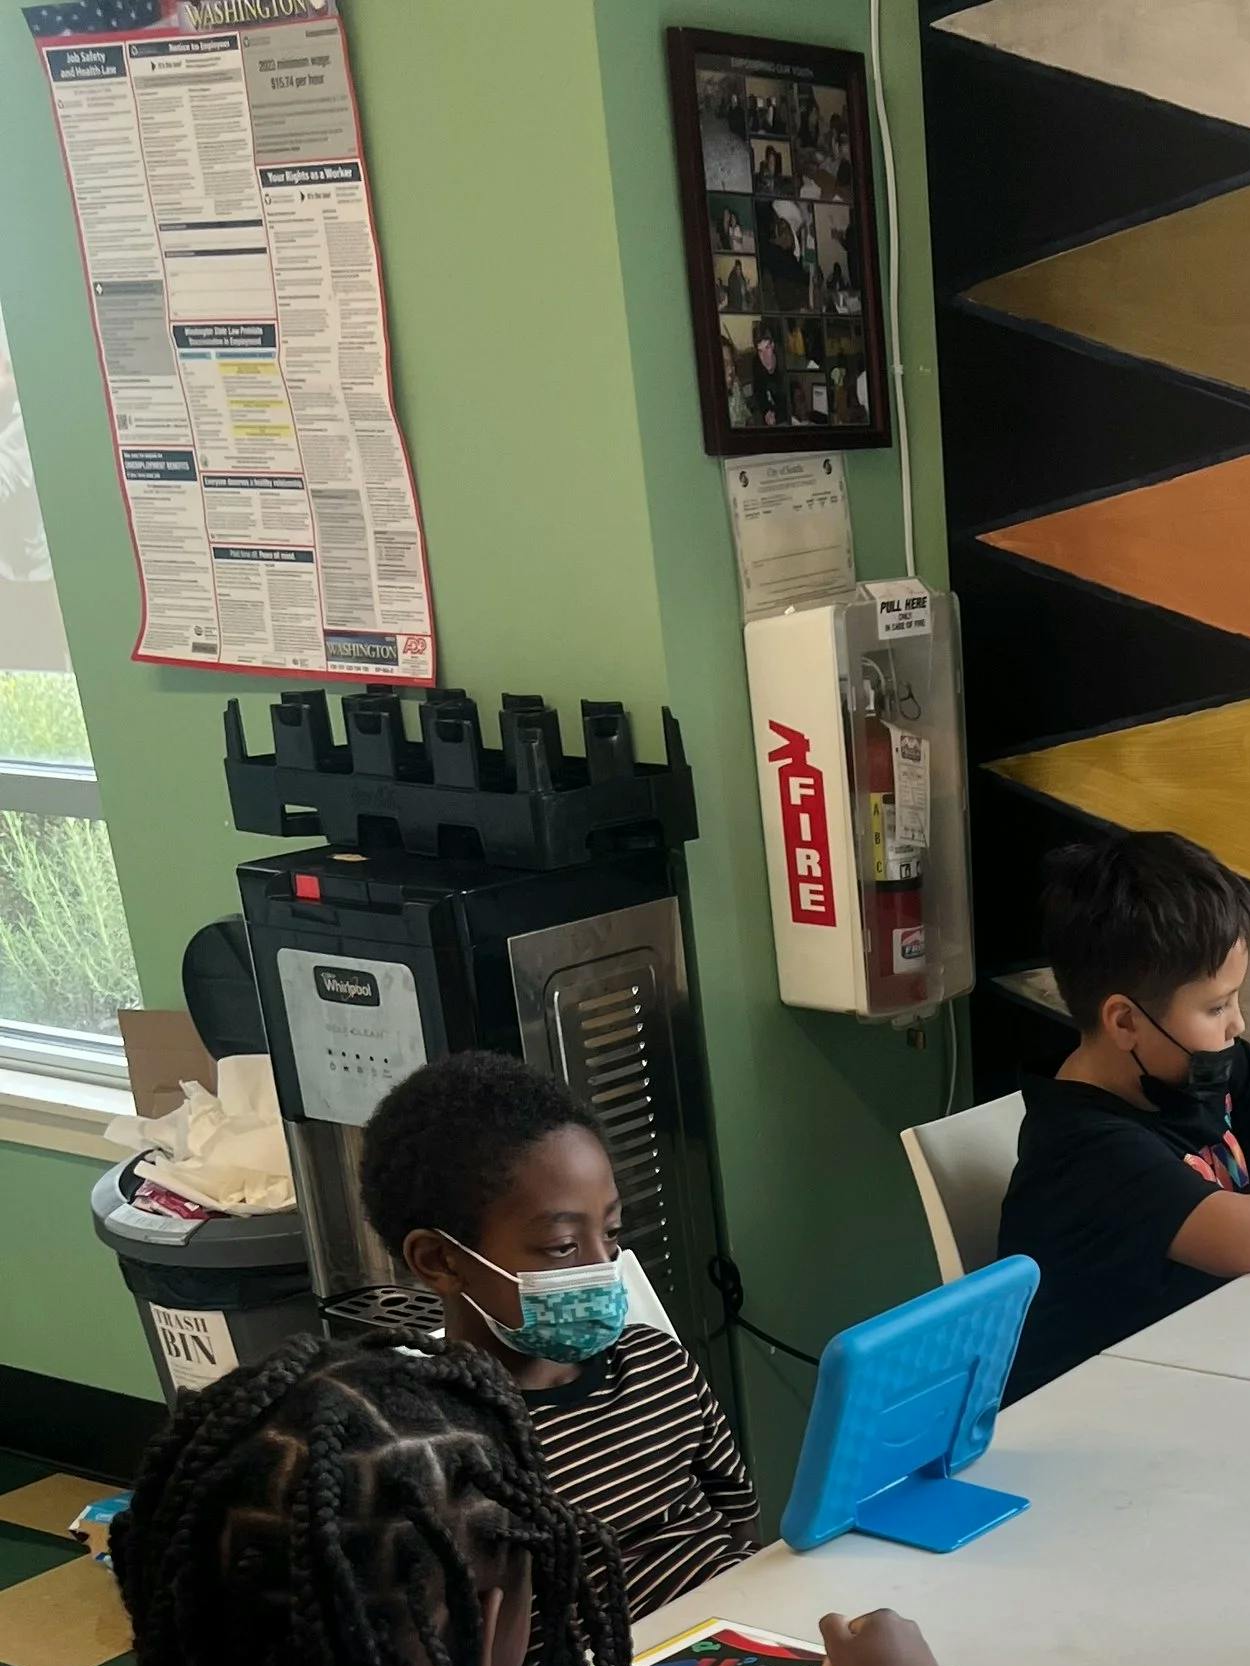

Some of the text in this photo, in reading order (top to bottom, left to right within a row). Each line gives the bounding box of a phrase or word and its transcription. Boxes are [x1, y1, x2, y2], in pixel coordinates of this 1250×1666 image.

[186, 0, 305, 30] WASHINGTON
[66, 50, 105, 63] Job Safety
[60, 64, 116, 78] and Health Law
[296, 77, 306, 88] per
[308, 74, 324, 86] hour
[267, 171, 284, 183] Your
[286, 169, 309, 184] Rights
[310, 171, 318, 180] as
[324, 166, 352, 180] Worker
[880, 596, 928, 614] PULL HERE
[326, 641, 396, 660] WASHINGTON
[788, 776, 827, 913] FIRE
[323, 977, 372, 998] Whirlpool
[154, 1307, 208, 1333] TRASH
[161, 1328, 216, 1365] BIN
